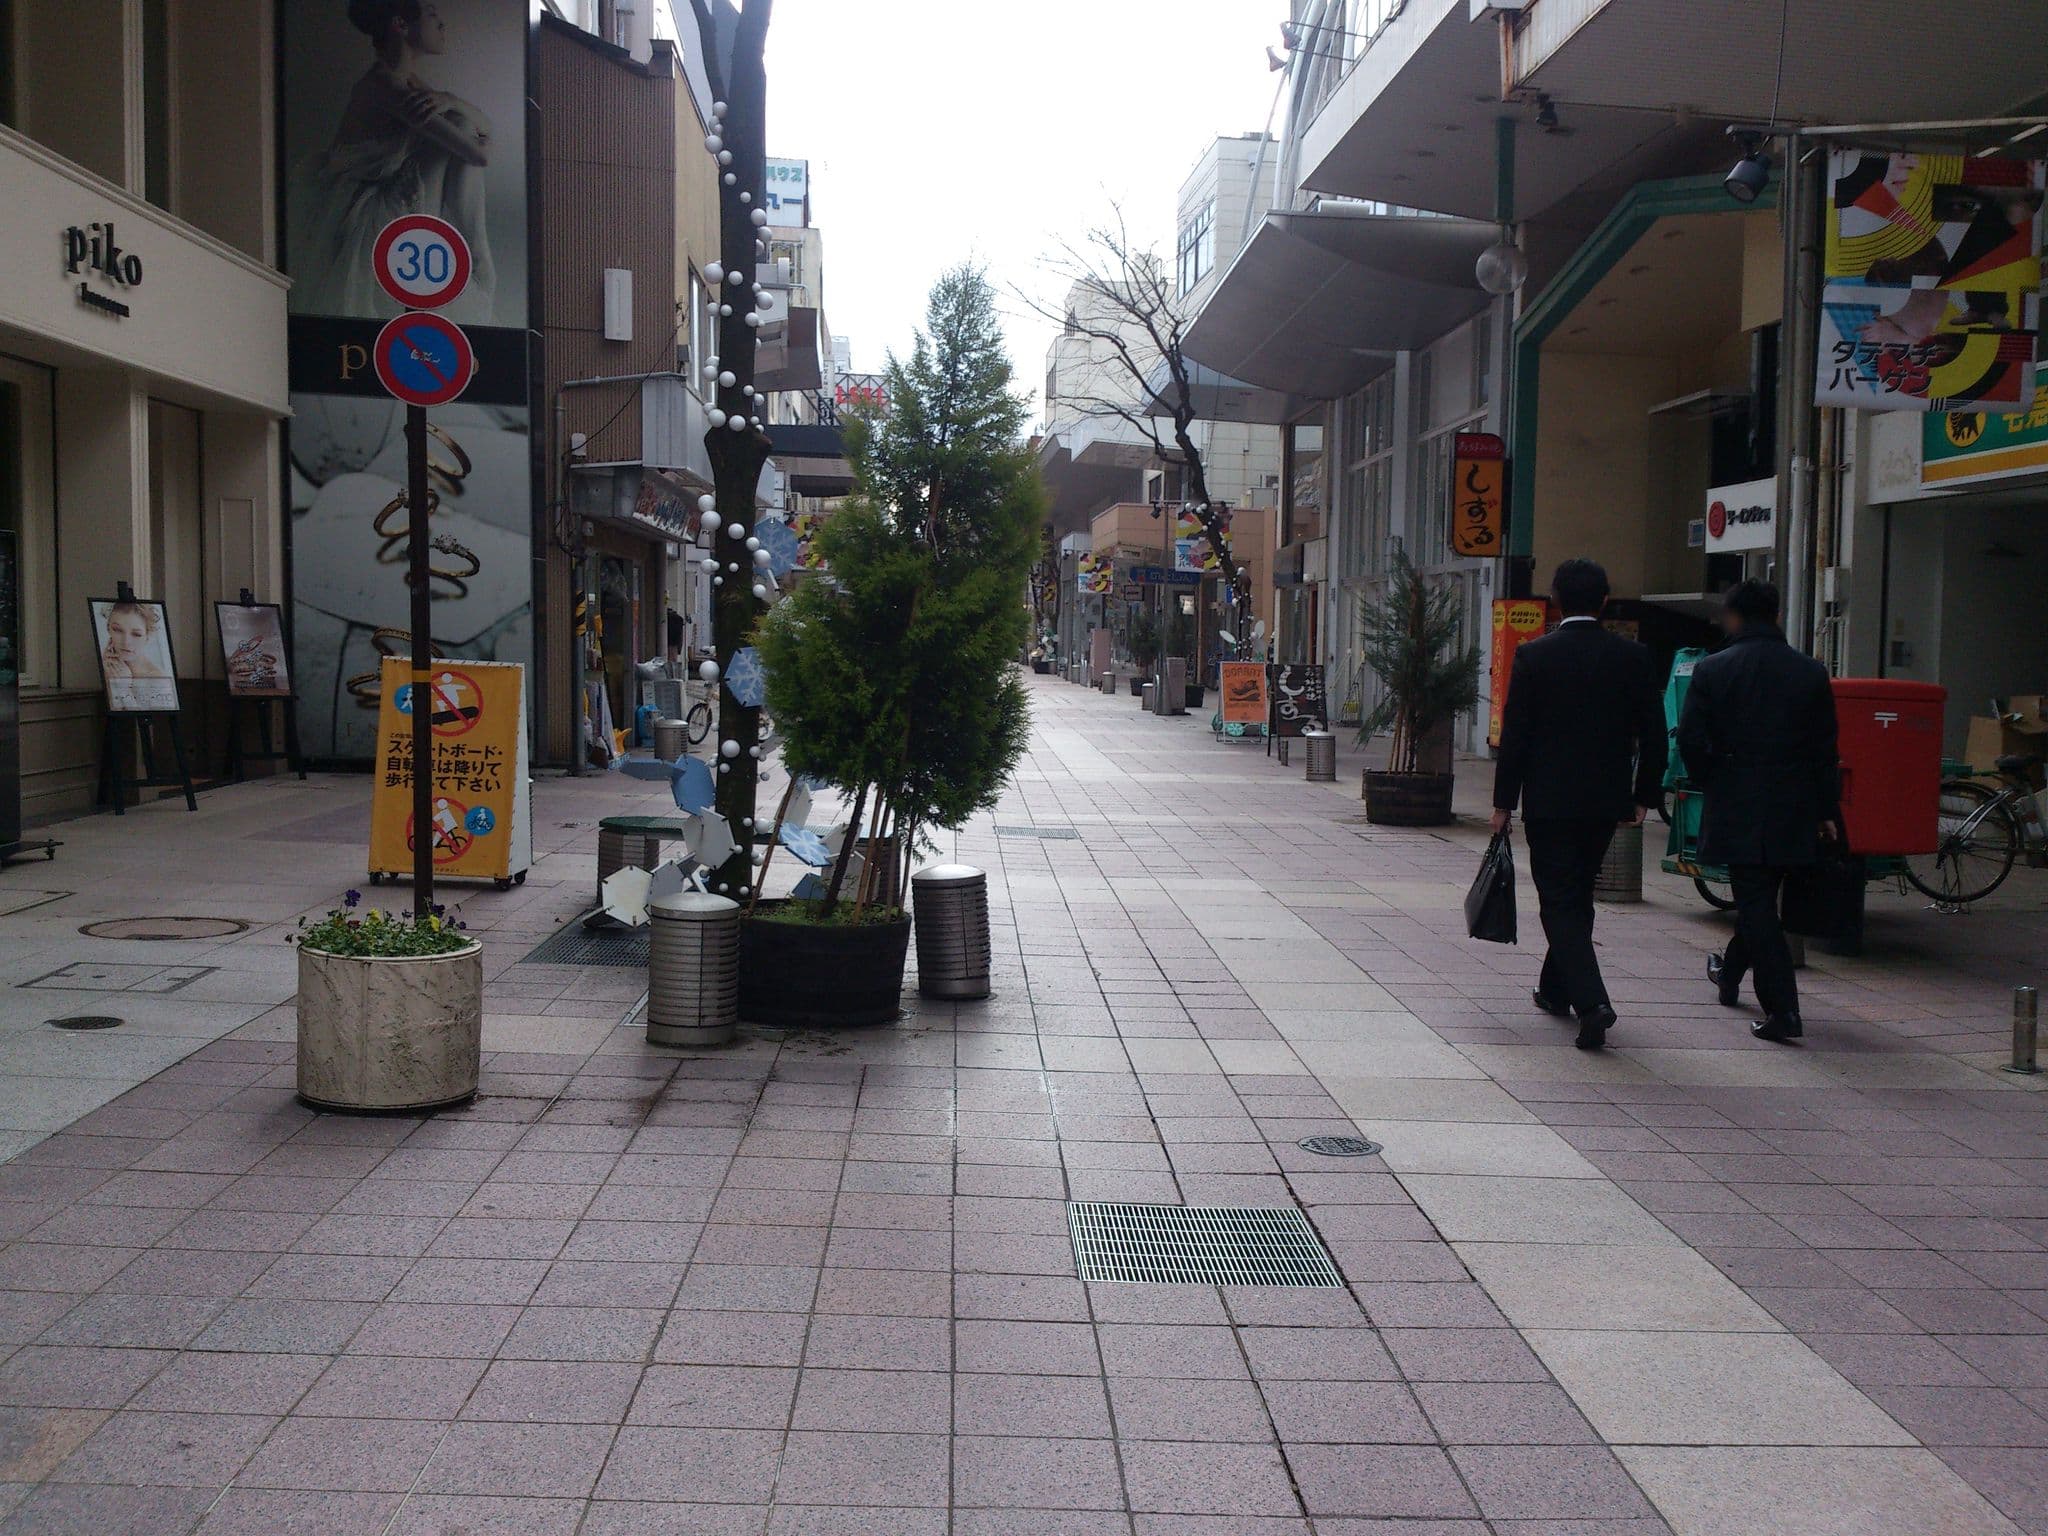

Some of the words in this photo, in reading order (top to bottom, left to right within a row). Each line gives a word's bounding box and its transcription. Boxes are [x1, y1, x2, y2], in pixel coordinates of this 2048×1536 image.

[67, 222, 143, 286] piko
[396, 241, 449, 283] 30
[1832, 340, 1940, 367] タテマチ
[1829, 367, 1933, 394] バーゲン
[388, 739, 503, 760] スケトボード・
[387, 756, 502, 777] 自転は降りて
[385, 773, 501, 793] 歩行て下さい
